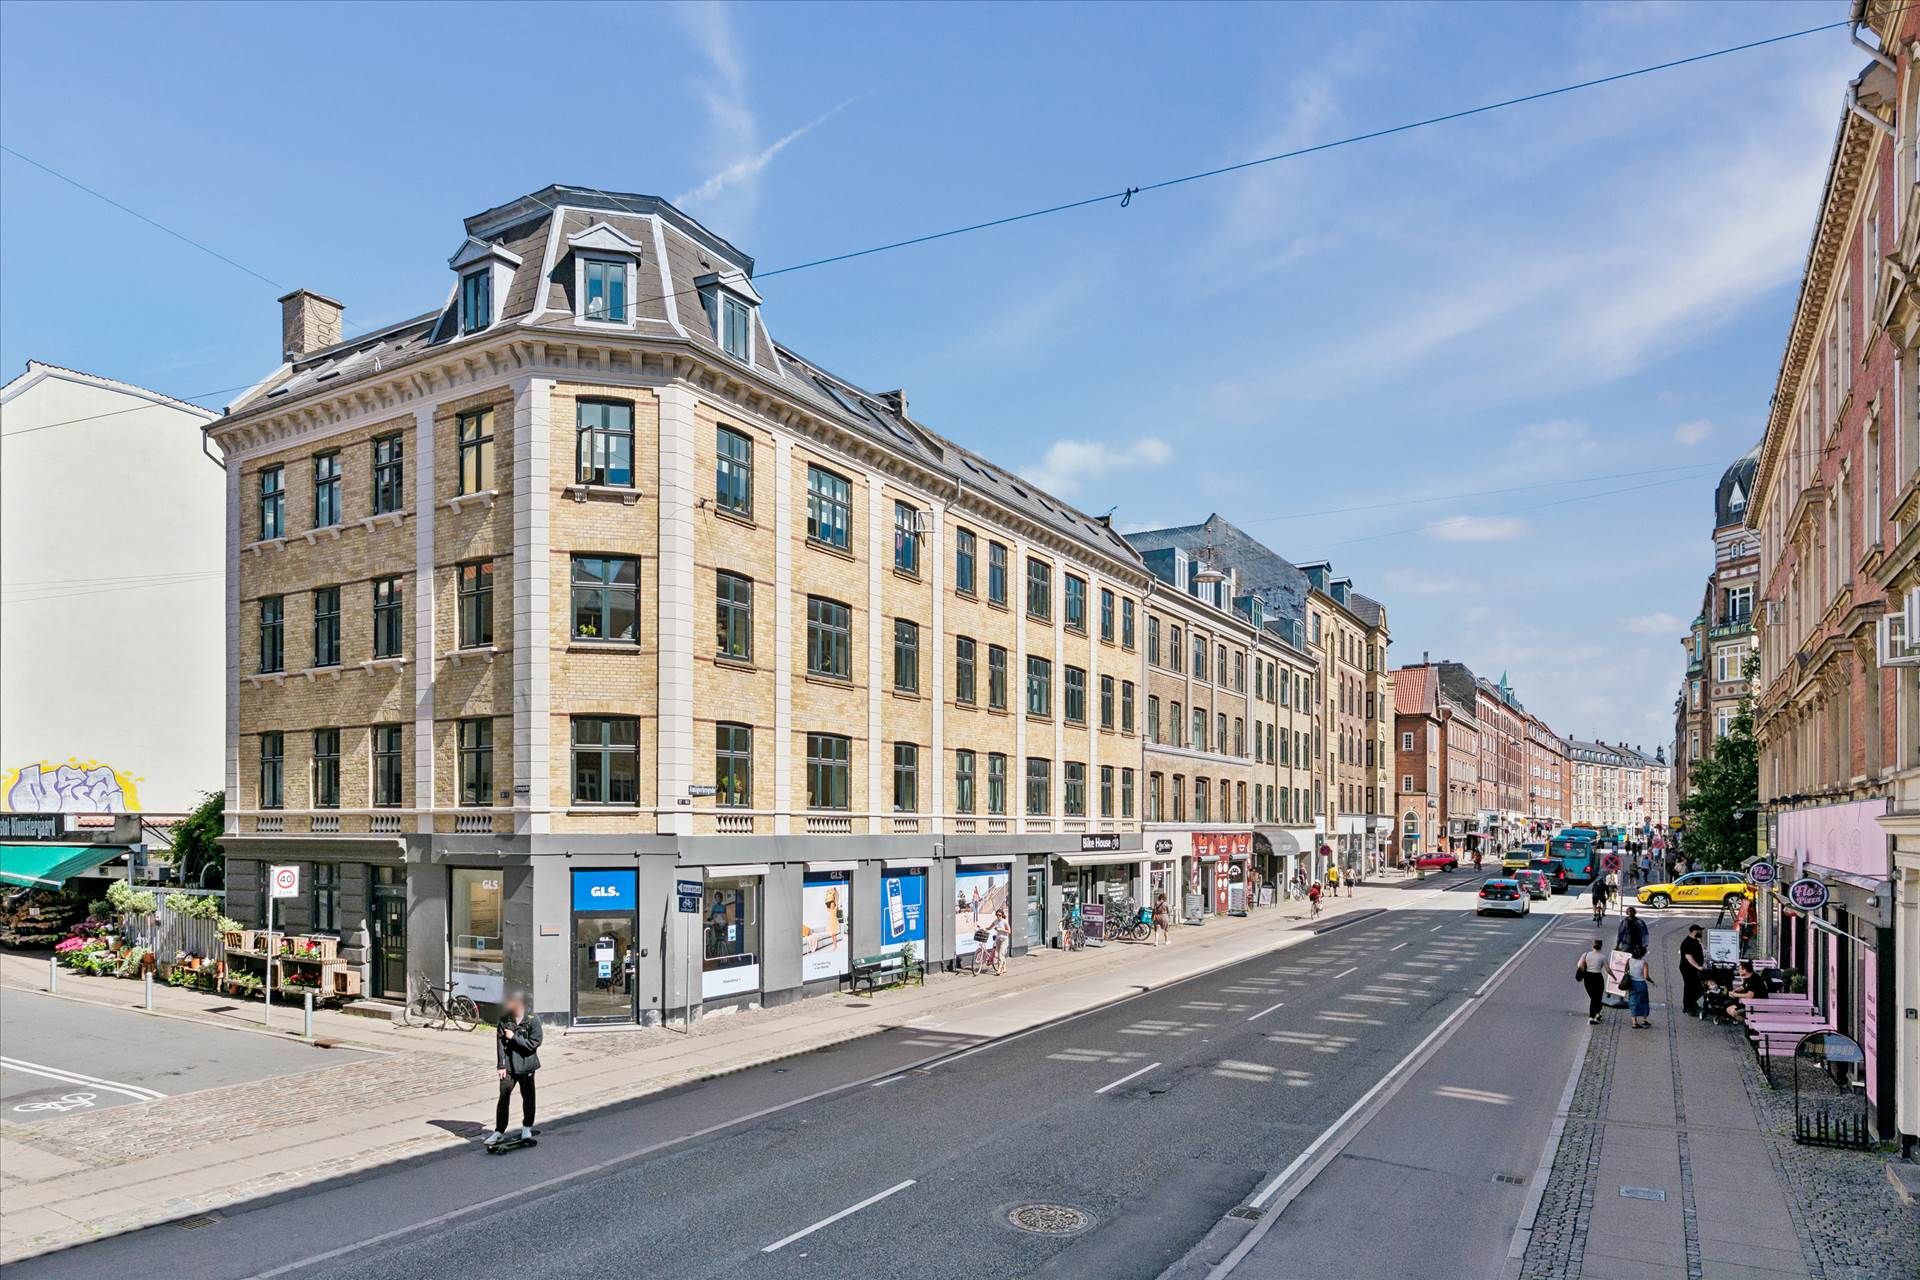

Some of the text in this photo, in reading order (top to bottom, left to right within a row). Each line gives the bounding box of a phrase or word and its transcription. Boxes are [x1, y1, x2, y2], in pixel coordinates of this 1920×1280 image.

[1082, 837, 1111, 848] Bike House
[280, 875, 292, 883] 40
[590, 886, 620, 897] GLS.
[1794, 884, 1823, 897] Flo's
